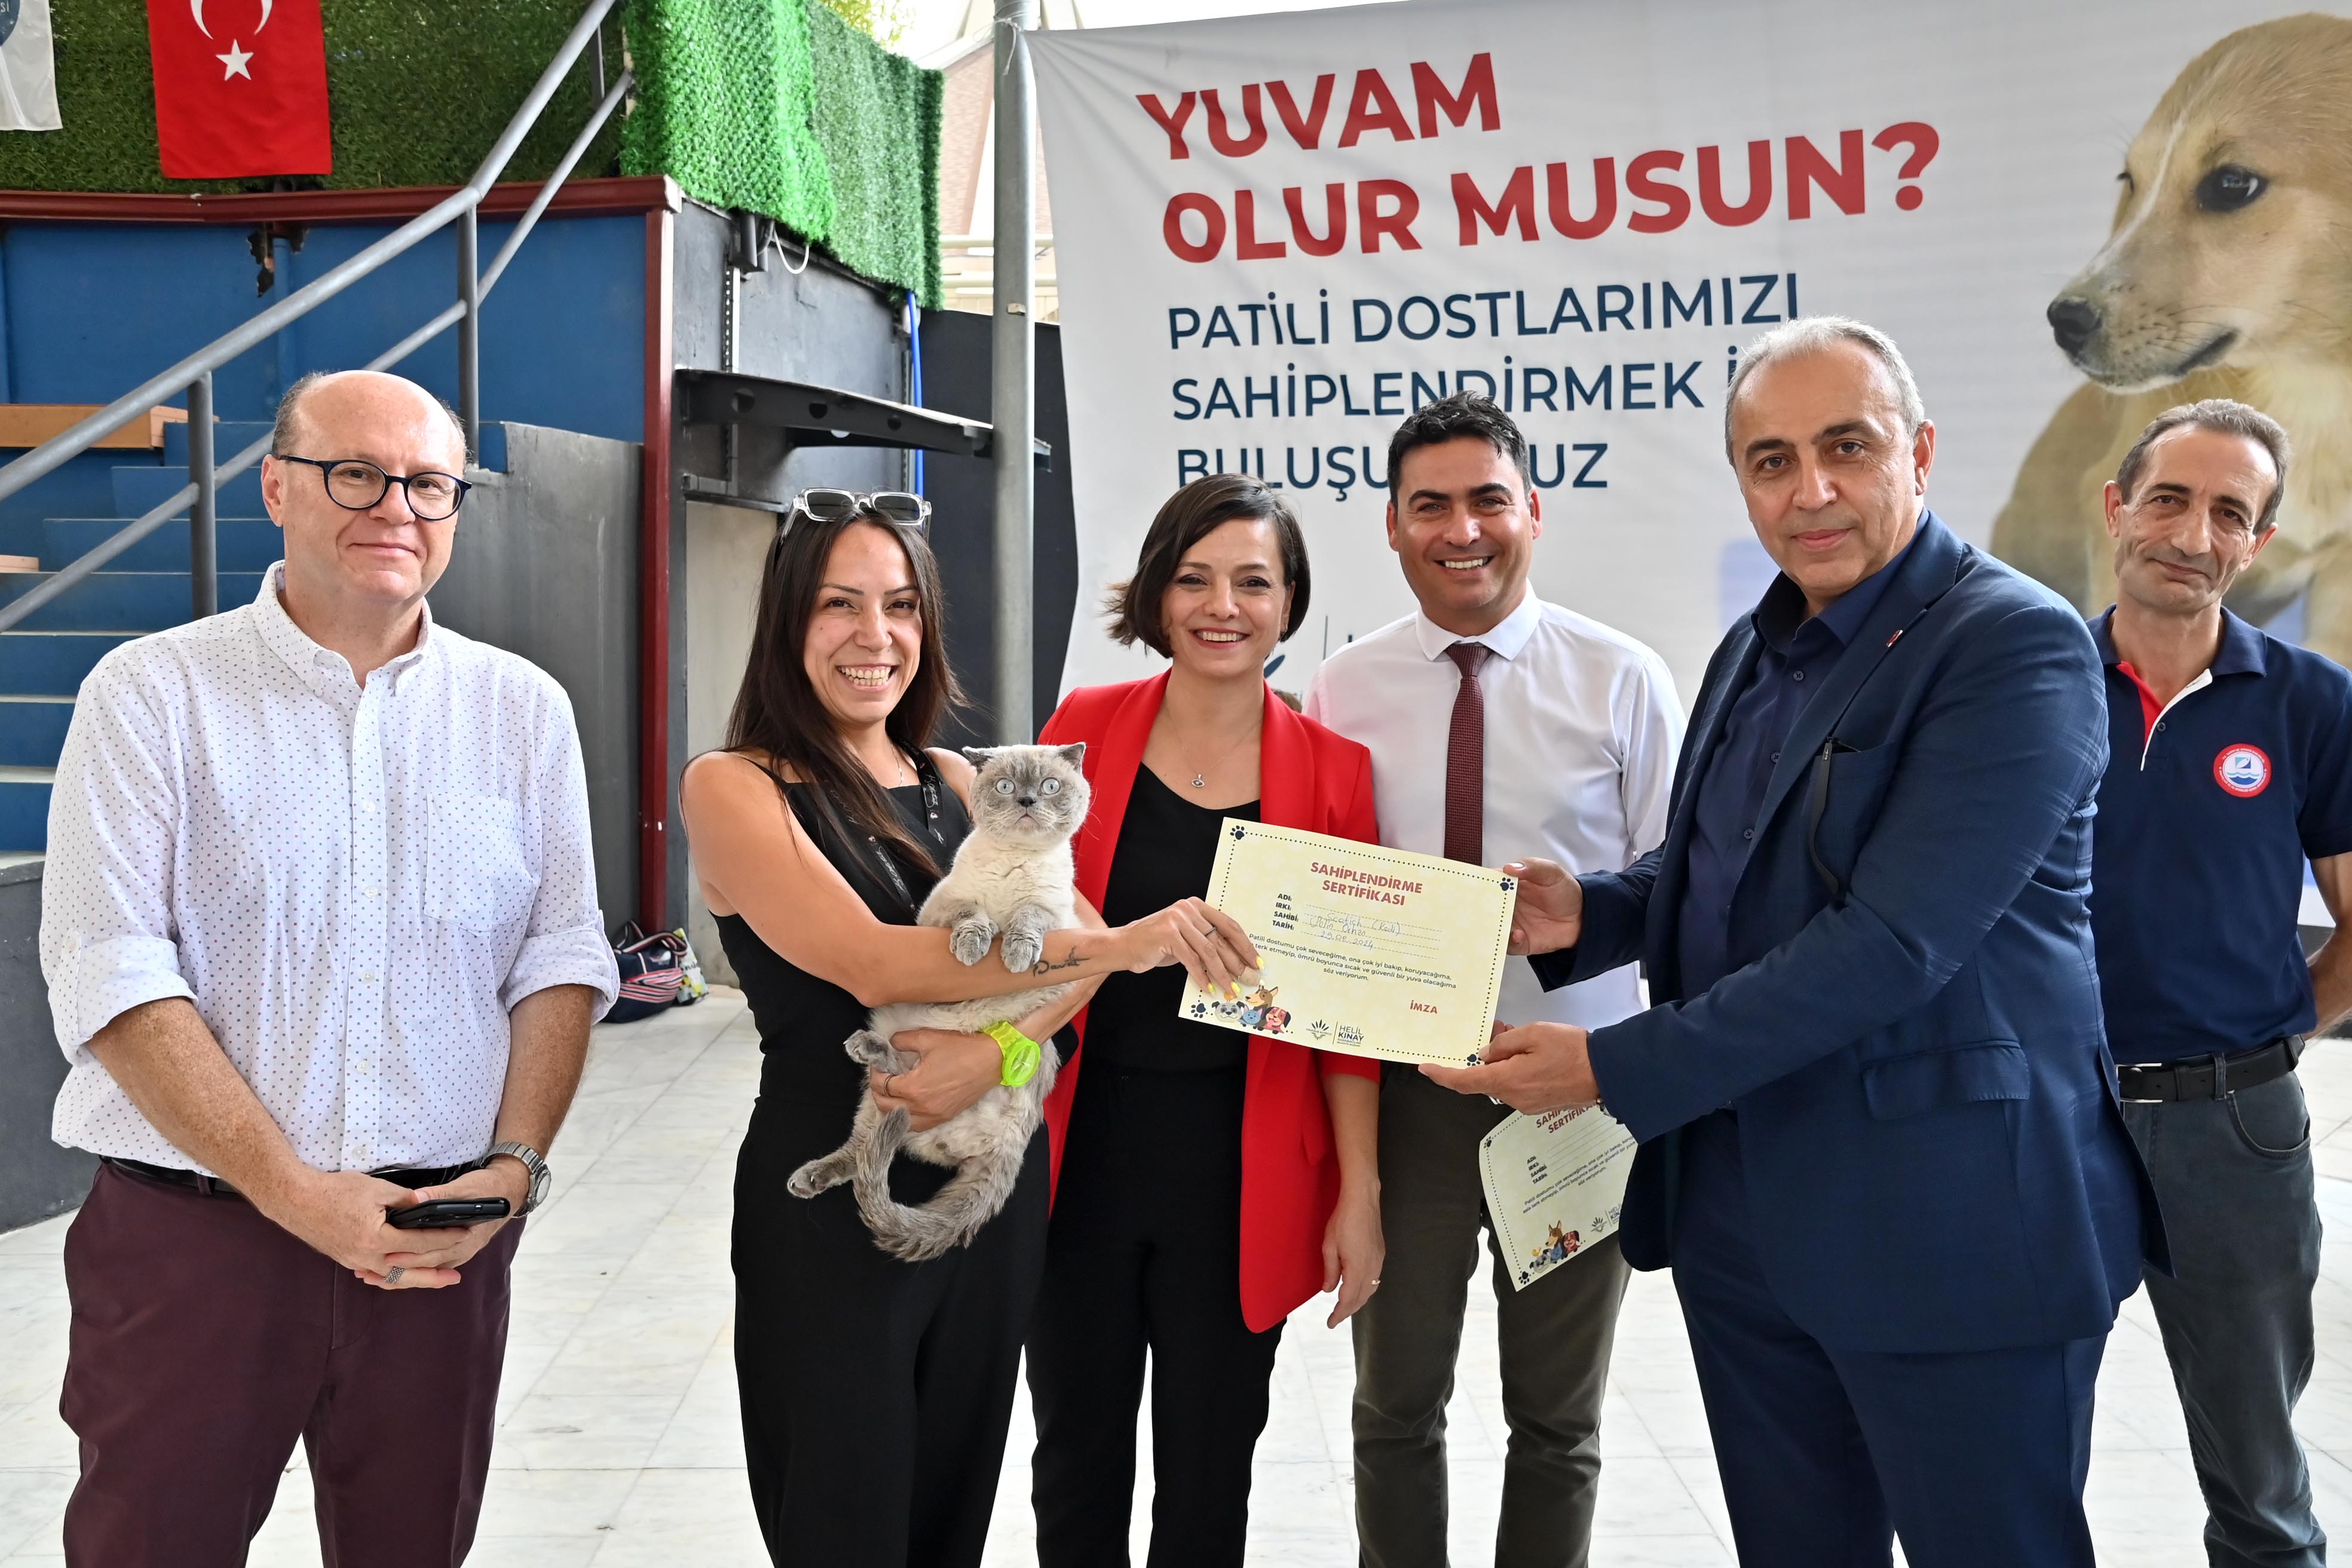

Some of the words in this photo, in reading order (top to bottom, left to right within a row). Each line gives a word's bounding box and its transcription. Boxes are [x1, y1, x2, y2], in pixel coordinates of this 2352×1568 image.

[1137, 52, 1501, 160] YUVAM
[1163, 179, 1423, 263] OLUR
[1450, 121, 1940, 246] MUSUN?
[1169, 289, 1329, 349] PATİLİ
[1353, 273, 1797, 342] DOSTLARIMIZI
[1178, 443, 1608, 501] BULUŞUUZ
[1310, 862, 1423, 894] SAHİPLENDİRME
[1277, 893, 1293, 902] ADI:
[1322, 880, 1405, 906] SERTİFİKASI
[1273, 911, 1299, 922] SAHİBİ:
[1275, 902, 1291, 911] IRKI:
[1272, 920, 1295, 930] TARİH:
[1249, 933, 1265, 942] Patili
[1266, 938, 1295, 949] dostumu
[1309, 948, 1348, 961] seveceğime,
[1384, 962, 1404, 972] bakıp,
[1404, 966, 1452, 981] koruyacağıma,
[1269, 947, 1296, 958] etmeyip,
[1297, 953, 1315, 961] ömrü
[1316, 957, 1344, 968] boyunca
[1371, 969, 1395, 978] güvenli
[1423, 978, 1457, 989] olacağıma
[1335, 970, 1369, 981] veriyorum.
[1410, 999, 1438, 1014] İMZA
[1338, 1031, 1365, 1042] KINAY
